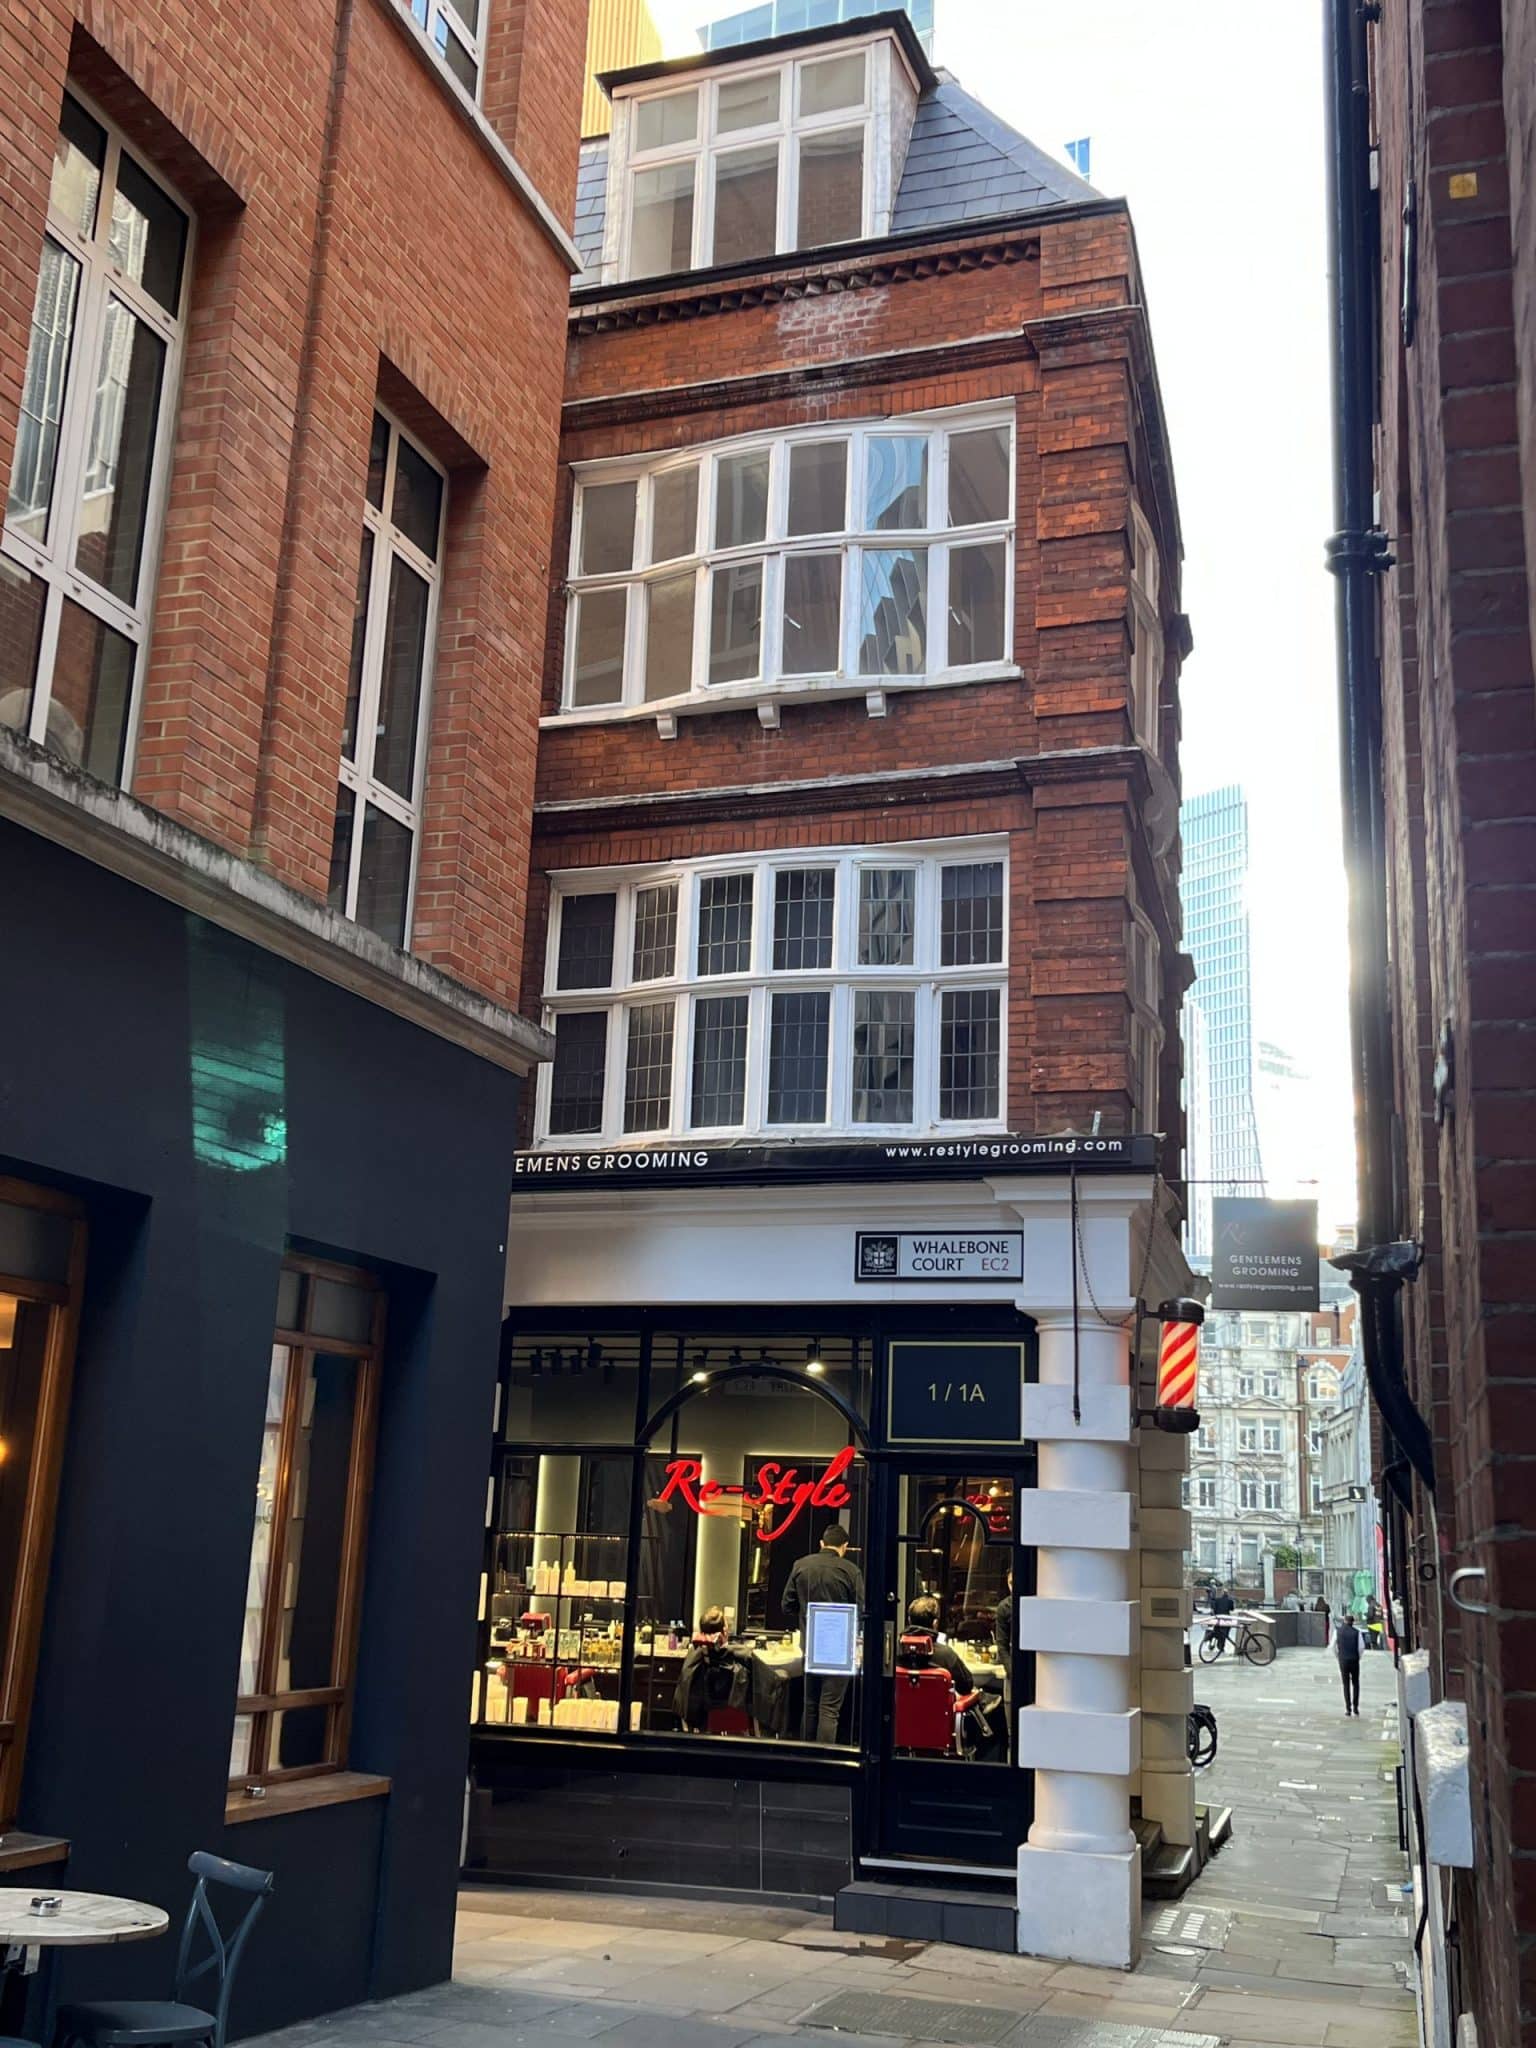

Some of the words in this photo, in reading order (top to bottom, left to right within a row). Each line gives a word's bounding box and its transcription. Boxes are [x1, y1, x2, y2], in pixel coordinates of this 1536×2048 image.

[587, 1151, 709, 1170] GROOMING
[885, 1138, 1123, 1159] www.restylegrooming.com
[912, 1240, 1009, 1255] WHALEBONE
[911, 1257, 964, 1272] COURT
[981, 1257, 1009, 1272] EC2
[1229, 1254, 1302, 1265] GENTLEMENS
[1231, 1266, 1299, 1277] GROOMING
[657, 1445, 856, 1542] Re-Style
